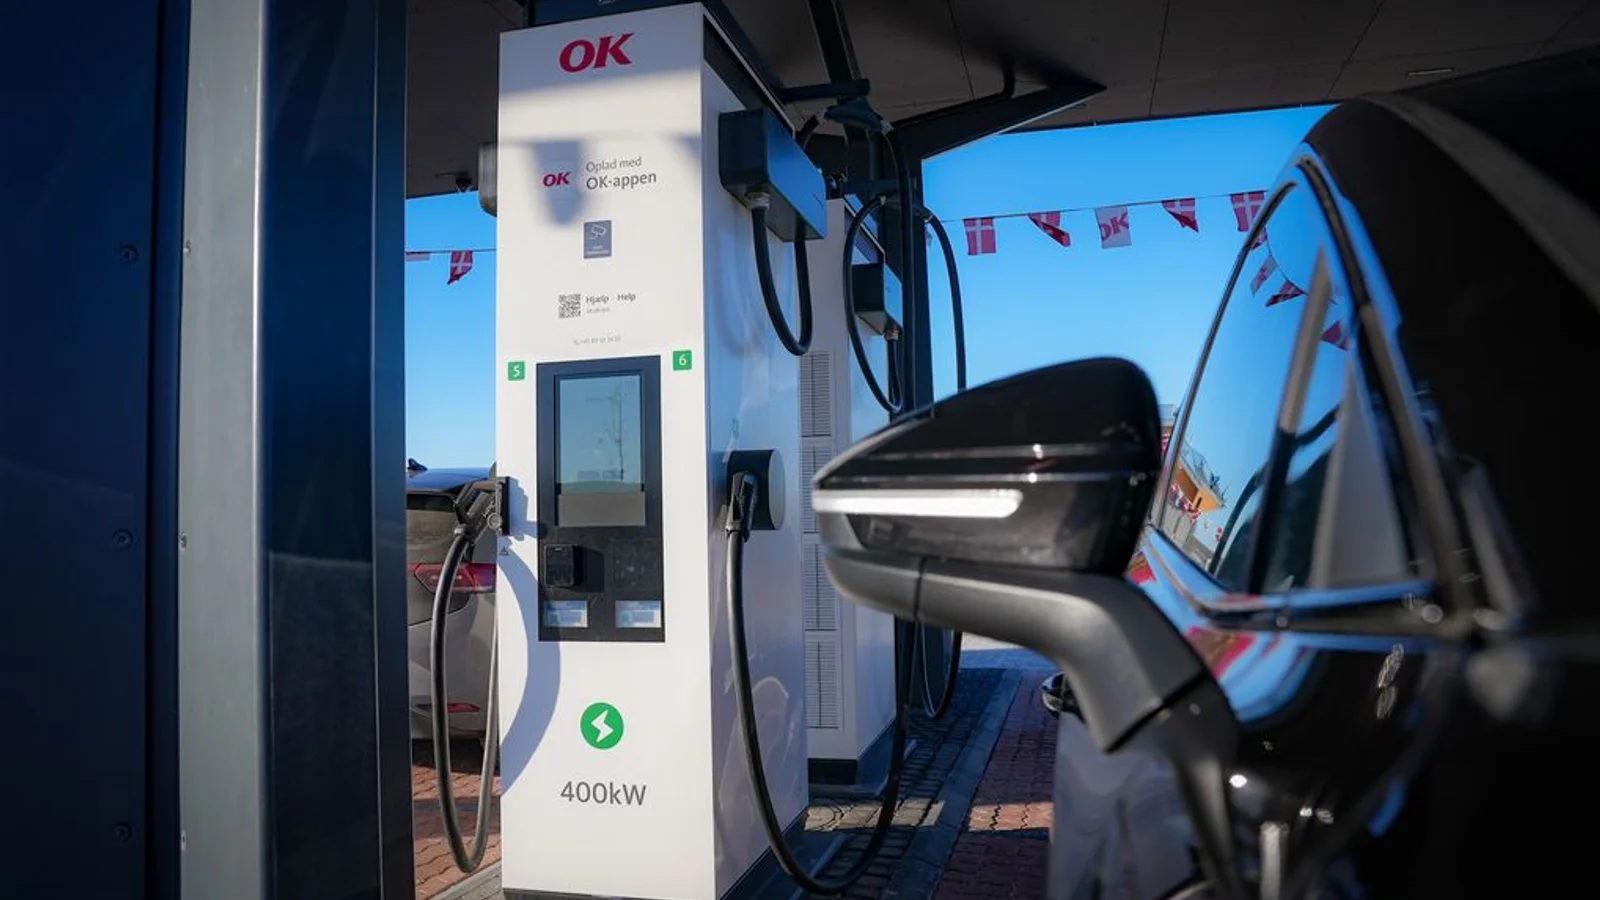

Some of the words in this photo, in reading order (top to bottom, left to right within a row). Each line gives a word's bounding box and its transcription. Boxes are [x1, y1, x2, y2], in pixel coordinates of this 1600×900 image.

[559, 32, 635, 73] OK
[586, 159, 617, 173] Oplad
[619, 156, 643, 169] med
[542, 171, 572, 188] OK
[586, 172, 657, 190] OK-appen
[617, 292, 637, 302] Help
[678, 354, 687, 366] 6
[512, 365, 520, 377] 5
[560, 781, 647, 806] 400kW
